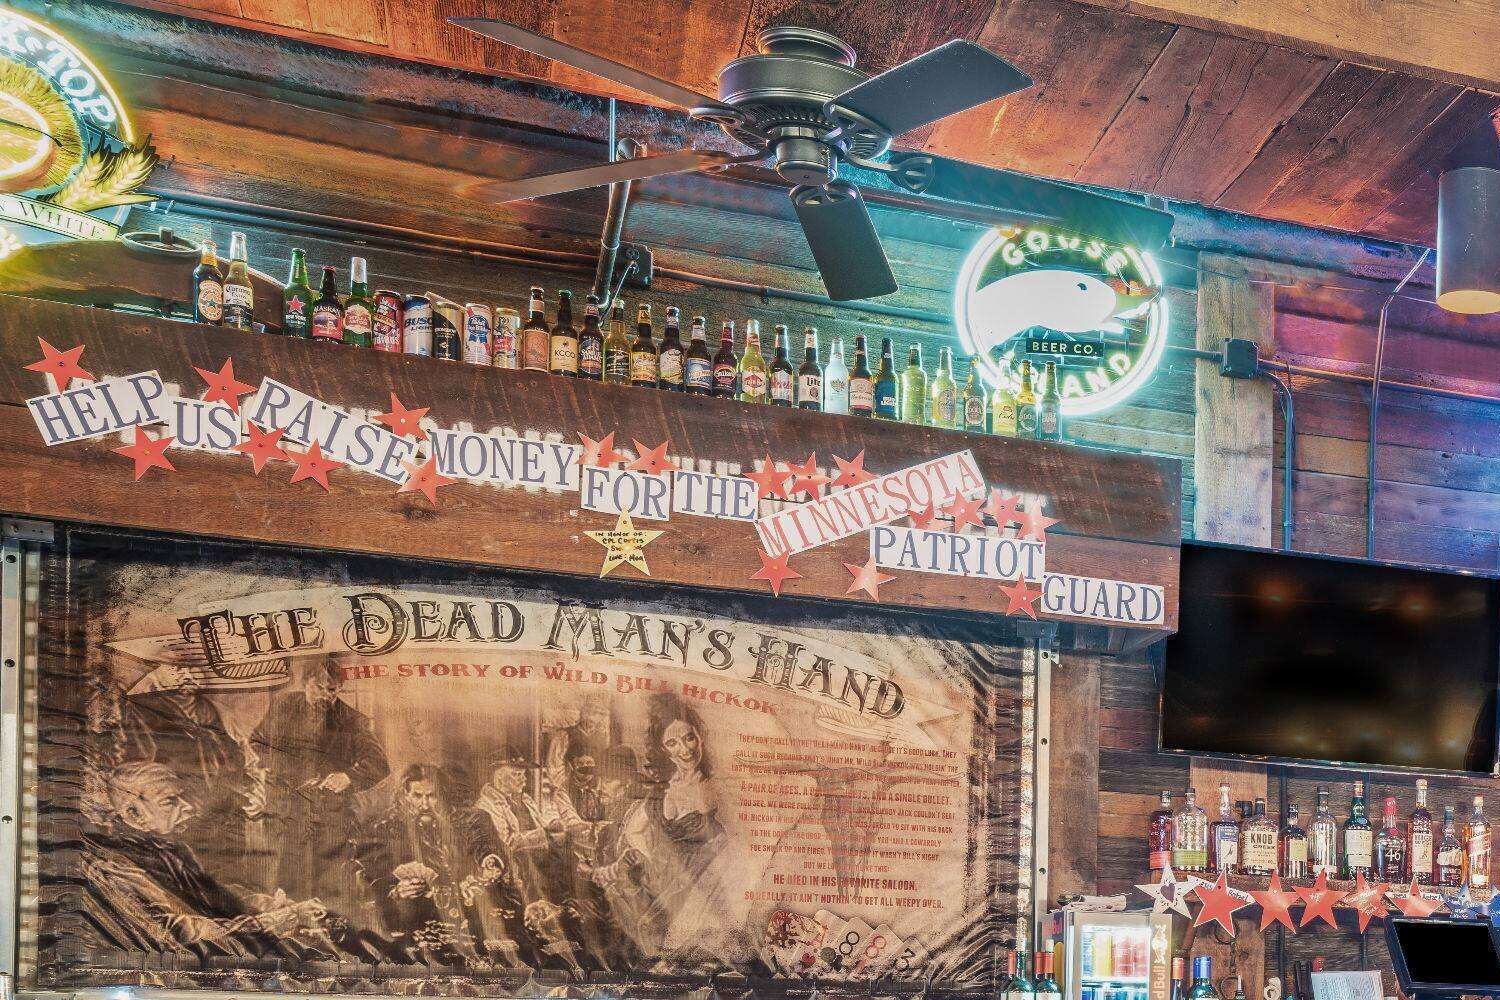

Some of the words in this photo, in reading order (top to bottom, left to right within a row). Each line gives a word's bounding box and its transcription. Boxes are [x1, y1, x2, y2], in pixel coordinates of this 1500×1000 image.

[20, 200, 105, 239] WHITE
[405, 317, 432, 327] BUSC
[1032, 341, 1067, 353] BEER
[1073, 343, 1098, 355] CO.
[34, 376, 164, 444] HELP
[173, 401, 237, 451] US
[251, 381, 413, 482] RAISE
[431, 432, 575, 486] MONEY
[586, 468, 667, 520] FOR
[677, 472, 756, 519] THE
[758, 457, 984, 556] MINNESOTA
[875, 527, 1043, 580] PATRIOT
[1044, 575, 1162, 622] GUARD
[177, 606, 325, 668] THE
[342, 592, 524, 657] DEAD
[543, 599, 735, 671] MAN'S
[747, 631, 906, 720] HAND
[340, 664, 390, 682] THE
[397, 663, 488, 679] STORY
[500, 663, 533, 679] OF
[543, 661, 607, 685] WILD
[616, 675, 674, 694] BILL
[682, 682, 780, 716] HICKOK
[895, 793, 921, 803] SINGLE
[1250, 832, 1273, 845] KNOB
[1385, 848, 1400, 862] 46
[773, 874, 784, 884] HE
[821, 876, 836, 887] HIS
[864, 896, 878, 906] GET
[880, 897, 893, 907] ALL
[895, 897, 921, 908] WEEPY
